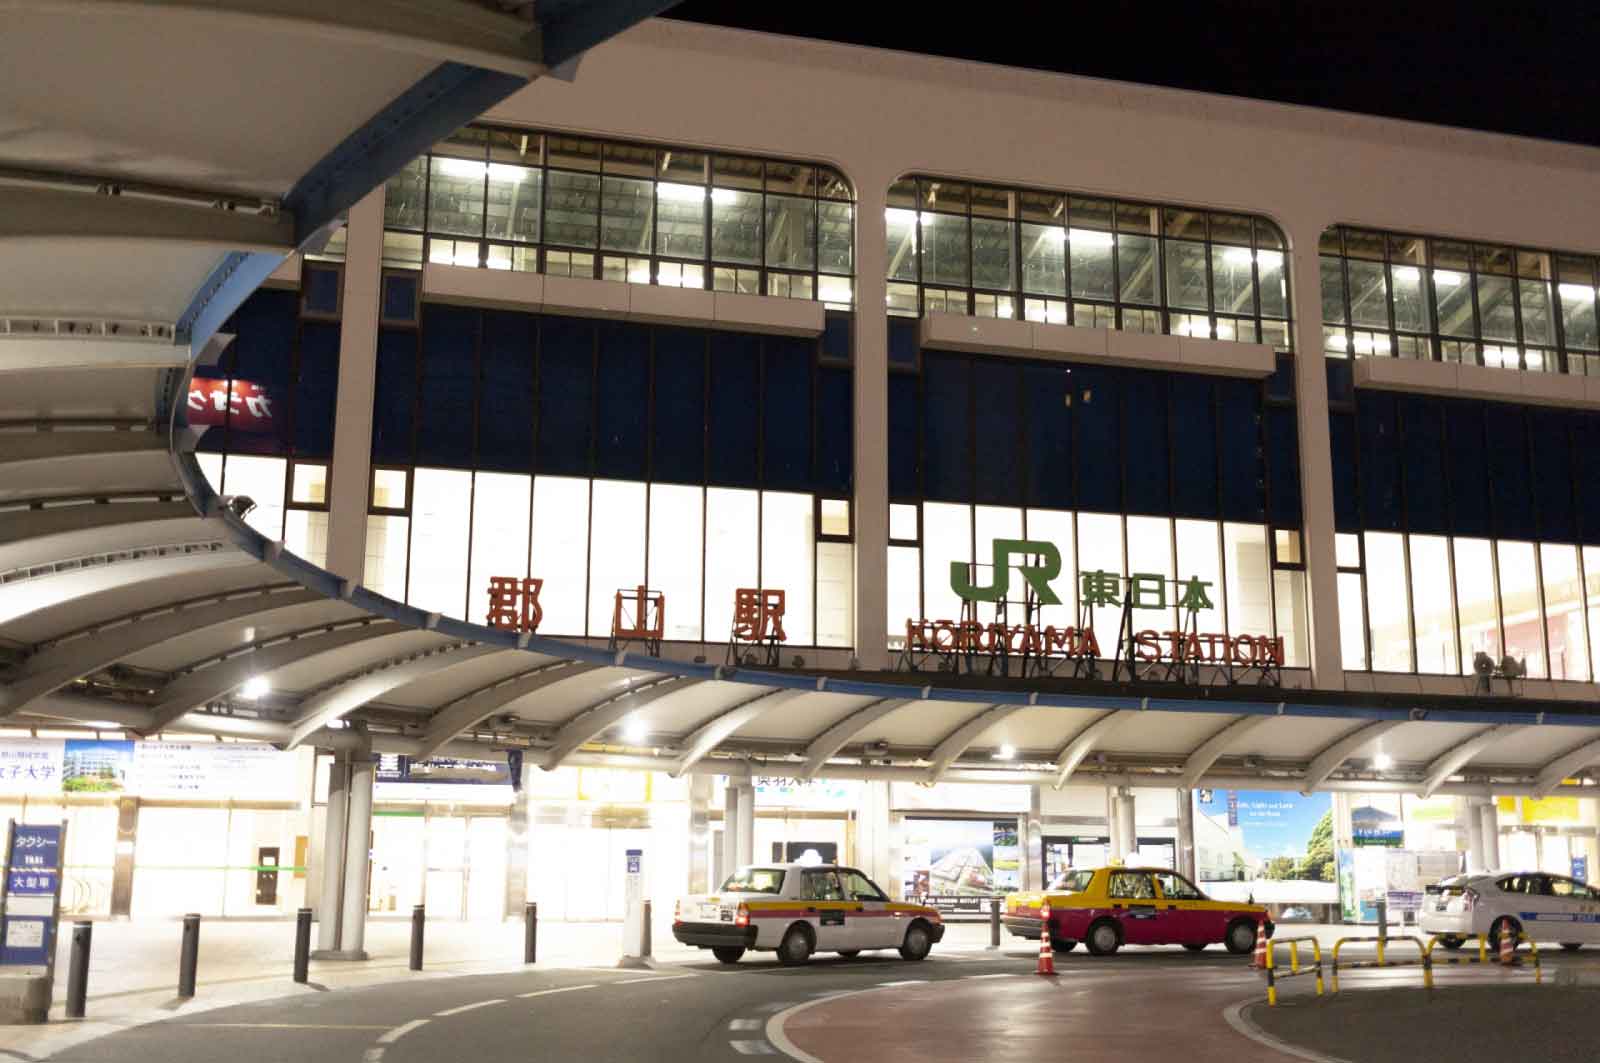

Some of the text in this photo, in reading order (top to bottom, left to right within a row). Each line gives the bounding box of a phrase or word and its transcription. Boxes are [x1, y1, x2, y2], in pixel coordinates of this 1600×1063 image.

[950, 538, 1062, 605] JR
[1080, 569, 1214, 612] 東日本
[1135, 629, 1285, 666] STATION
[16, 835, 57, 848] タクシー
[14, 876, 50, 889] 大型車
